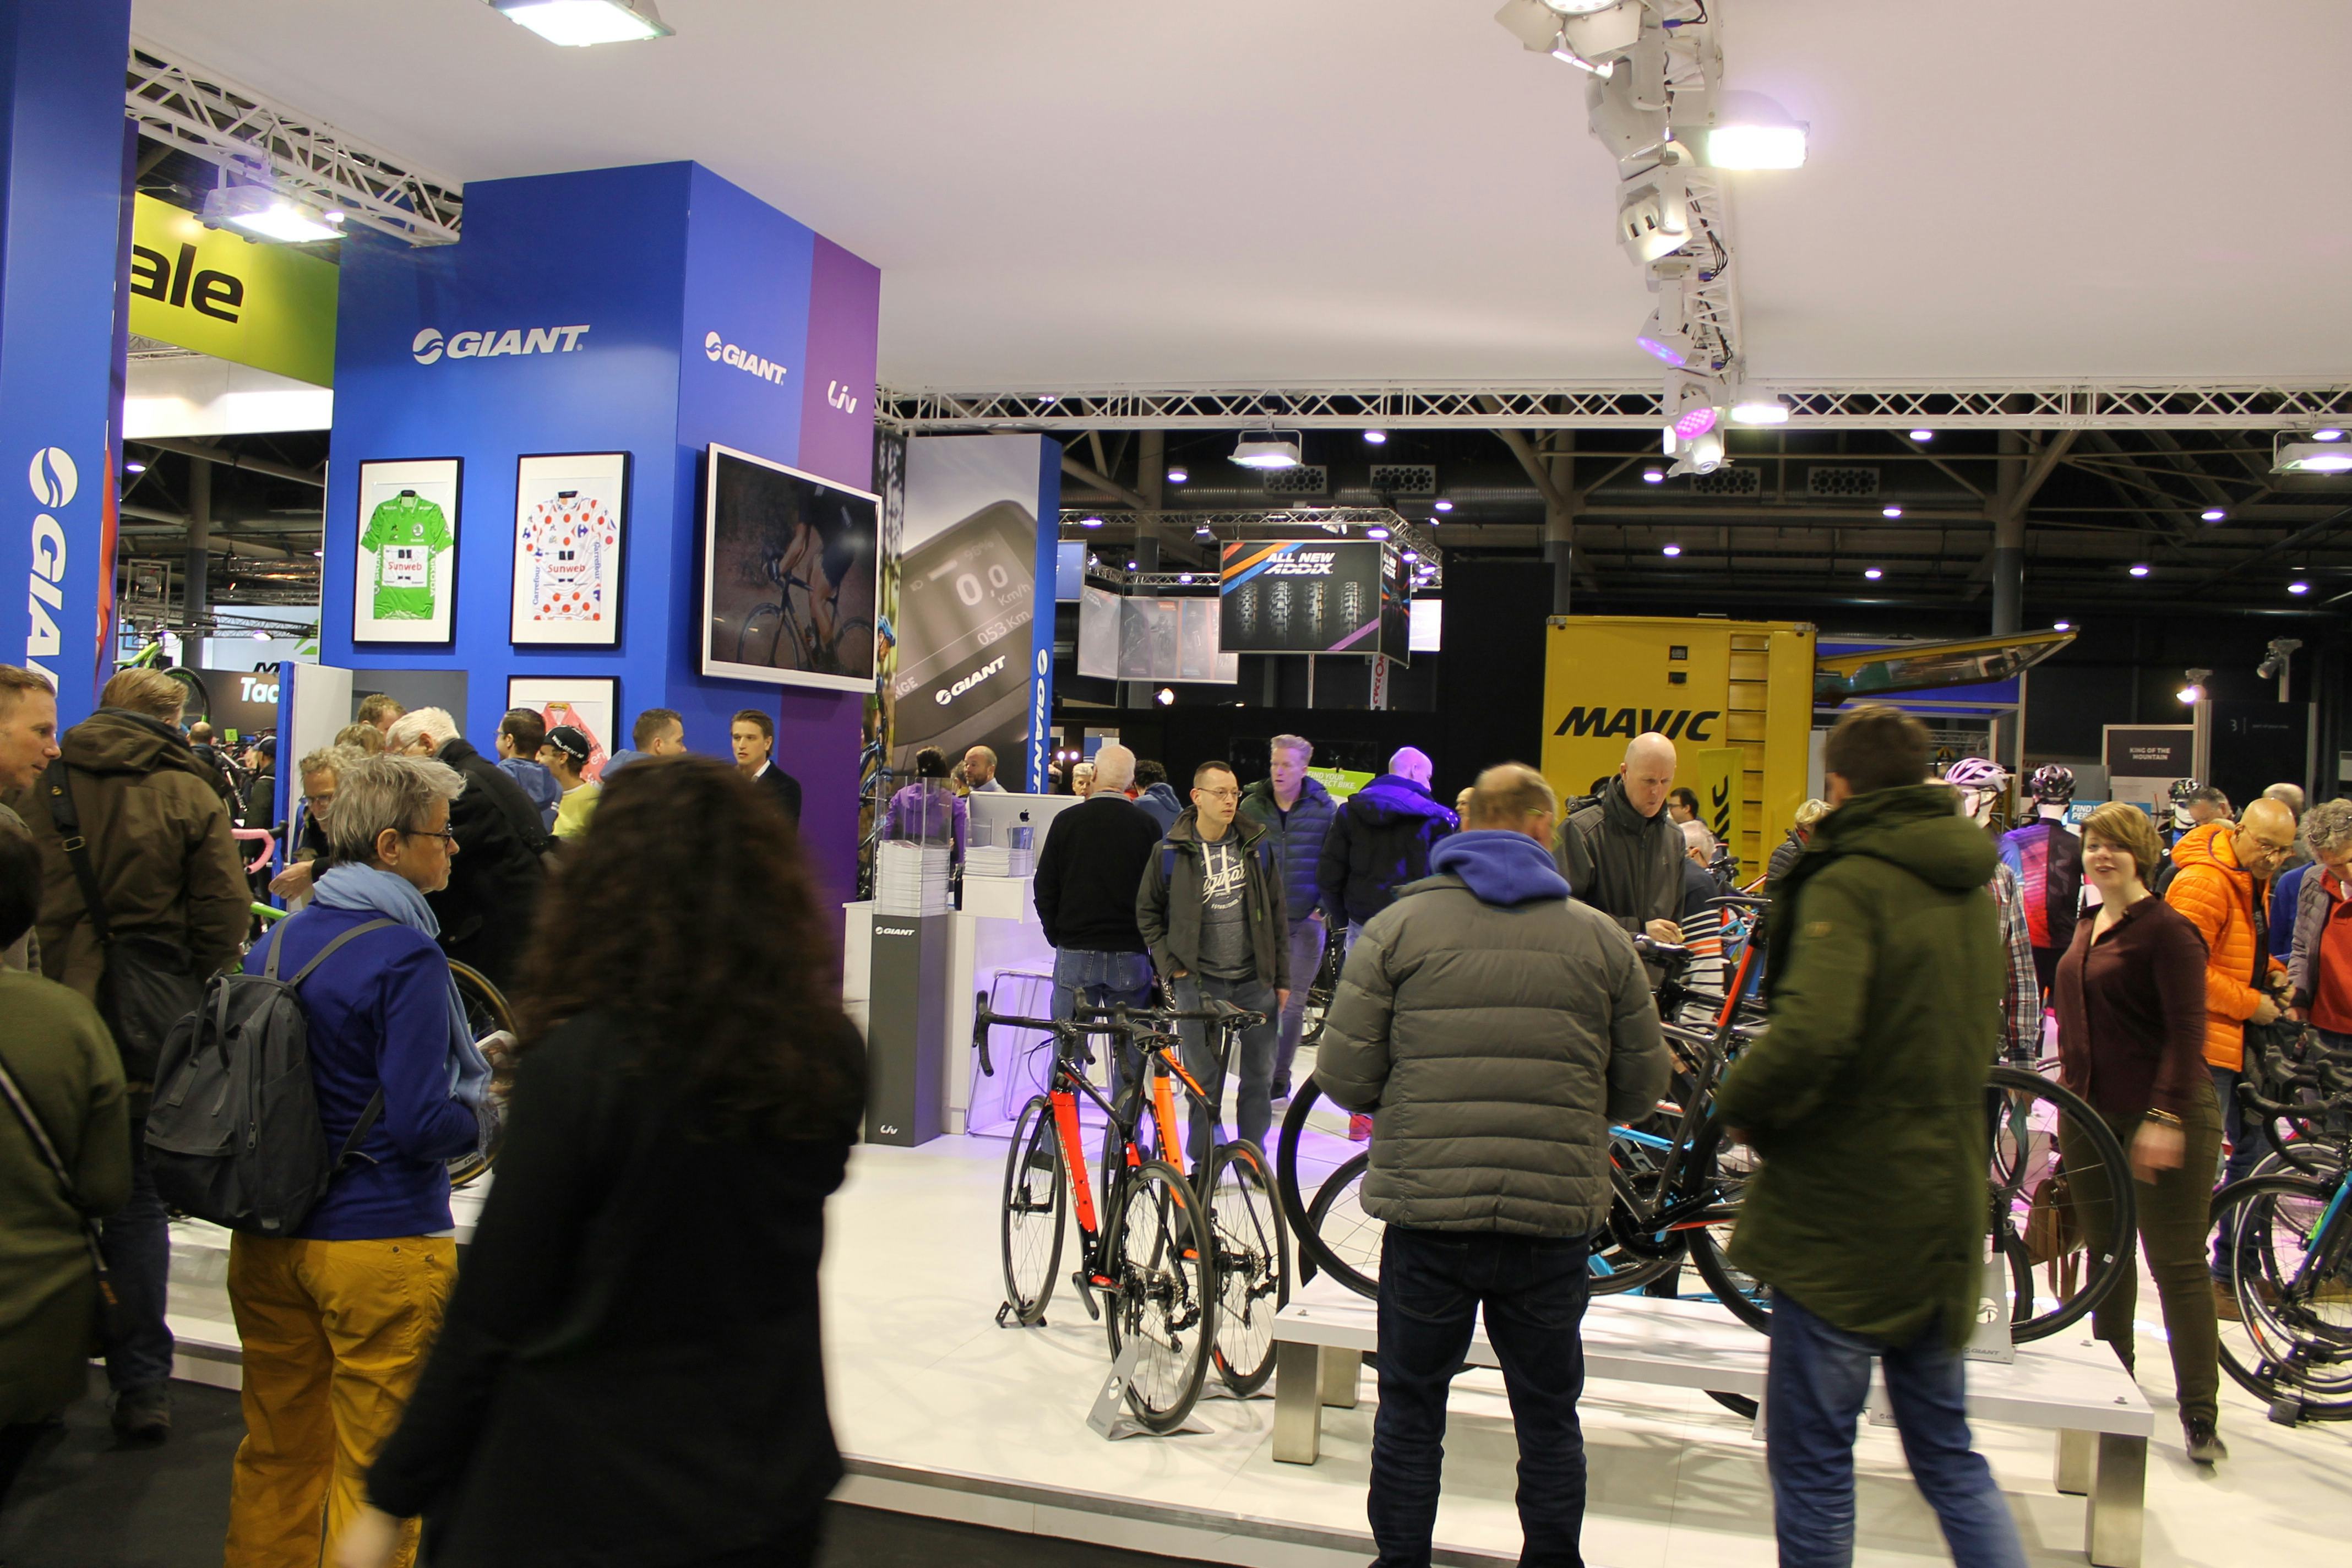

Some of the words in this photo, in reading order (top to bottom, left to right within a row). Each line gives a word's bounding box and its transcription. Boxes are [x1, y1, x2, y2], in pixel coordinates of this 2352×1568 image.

[130, 242, 244, 324] ale
[446, 324, 590, 358] GIANT
[722, 346, 787, 385] GIANT
[827, 379, 858, 413] Liv
[388, 562, 422, 571] Sunweb
[548, 564, 586, 573] Sunweb
[1266, 552, 1295, 563] ALL
[1298, 552, 1336, 563] NEW
[532, 567, 541, 605] Carrefour
[998, 582, 1032, 606] Km/h
[977, 622, 1007, 645] 053
[1005, 610, 1031, 629] Km
[241, 677, 280, 704] Tac
[951, 655, 1006, 696] GIANT
[1033, 678, 1045, 794] GIANT
[1554, 706, 1721, 741] MAVIC
[883, 928, 916, 936] GIANT
[880, 1125, 898, 1134] Liv
